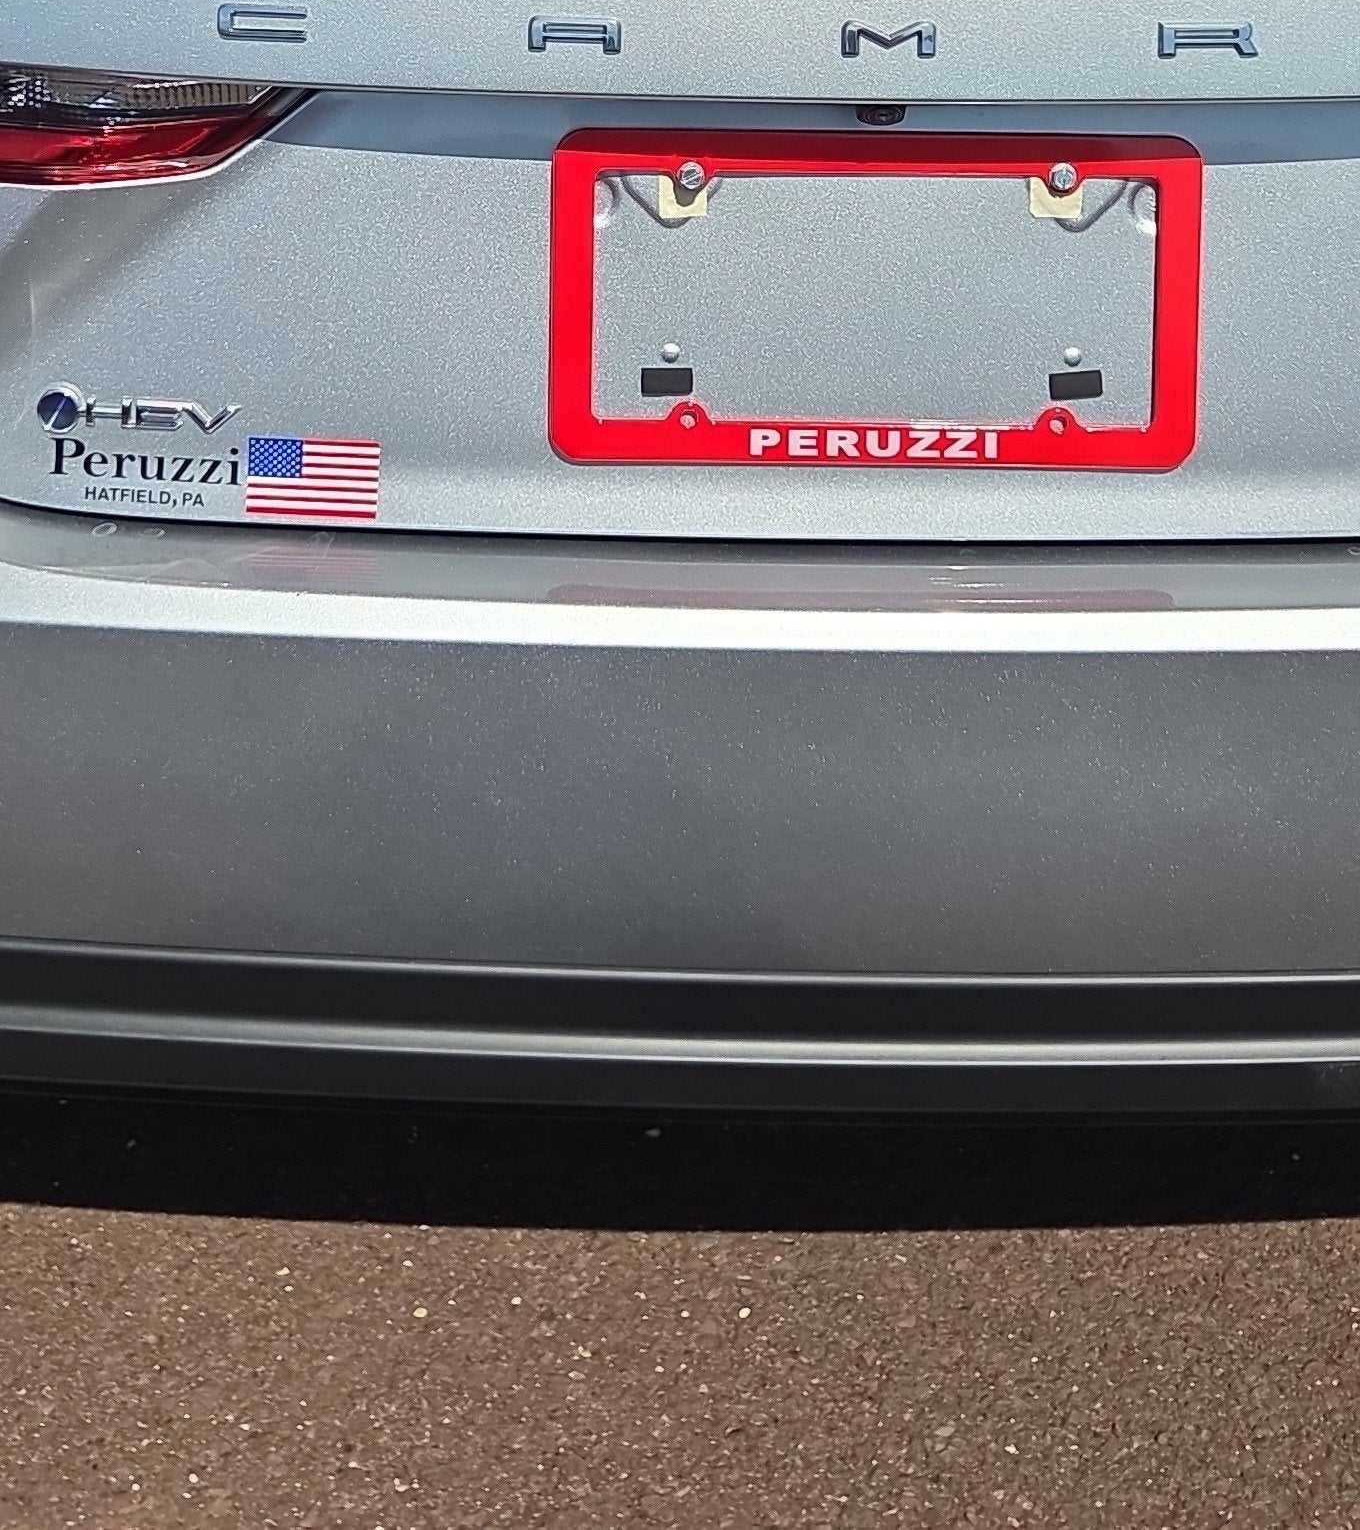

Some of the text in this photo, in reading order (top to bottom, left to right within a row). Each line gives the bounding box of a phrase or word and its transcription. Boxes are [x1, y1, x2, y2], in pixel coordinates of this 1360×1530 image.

[84, 394, 243, 434] HEV
[48, 436, 242, 486] Peruzzi
[748, 427, 999, 459] PERUZZI
[84, 486, 205, 509] HATFIELD, PA
